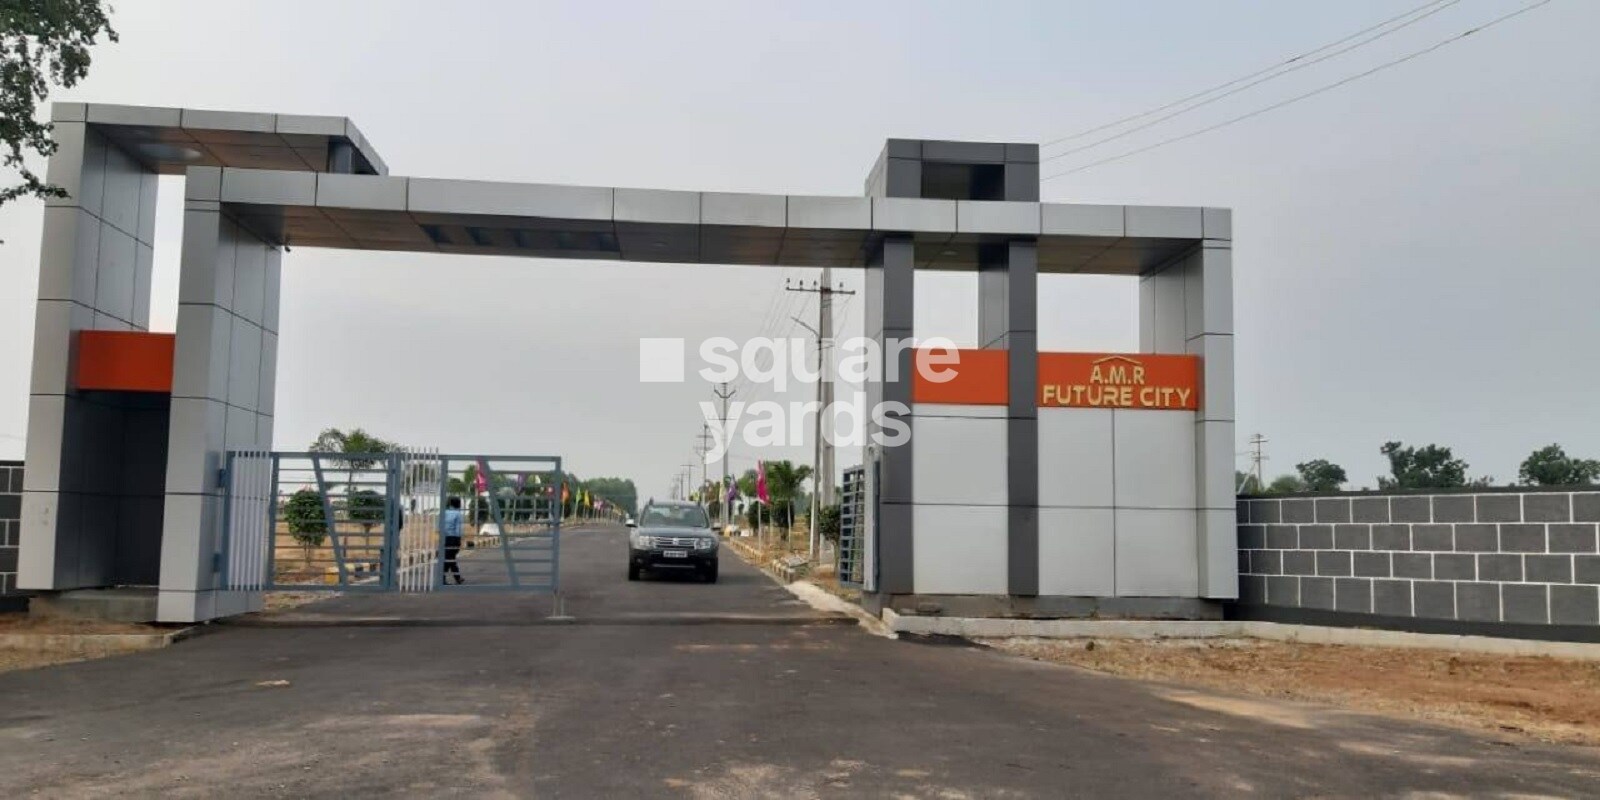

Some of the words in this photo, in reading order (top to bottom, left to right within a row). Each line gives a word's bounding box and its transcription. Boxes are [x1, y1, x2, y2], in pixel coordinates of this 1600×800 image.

[1090, 365, 1145, 385] A.M.R
[1043, 384, 1132, 406] FUTURE
[1139, 387, 1191, 407] CITY
